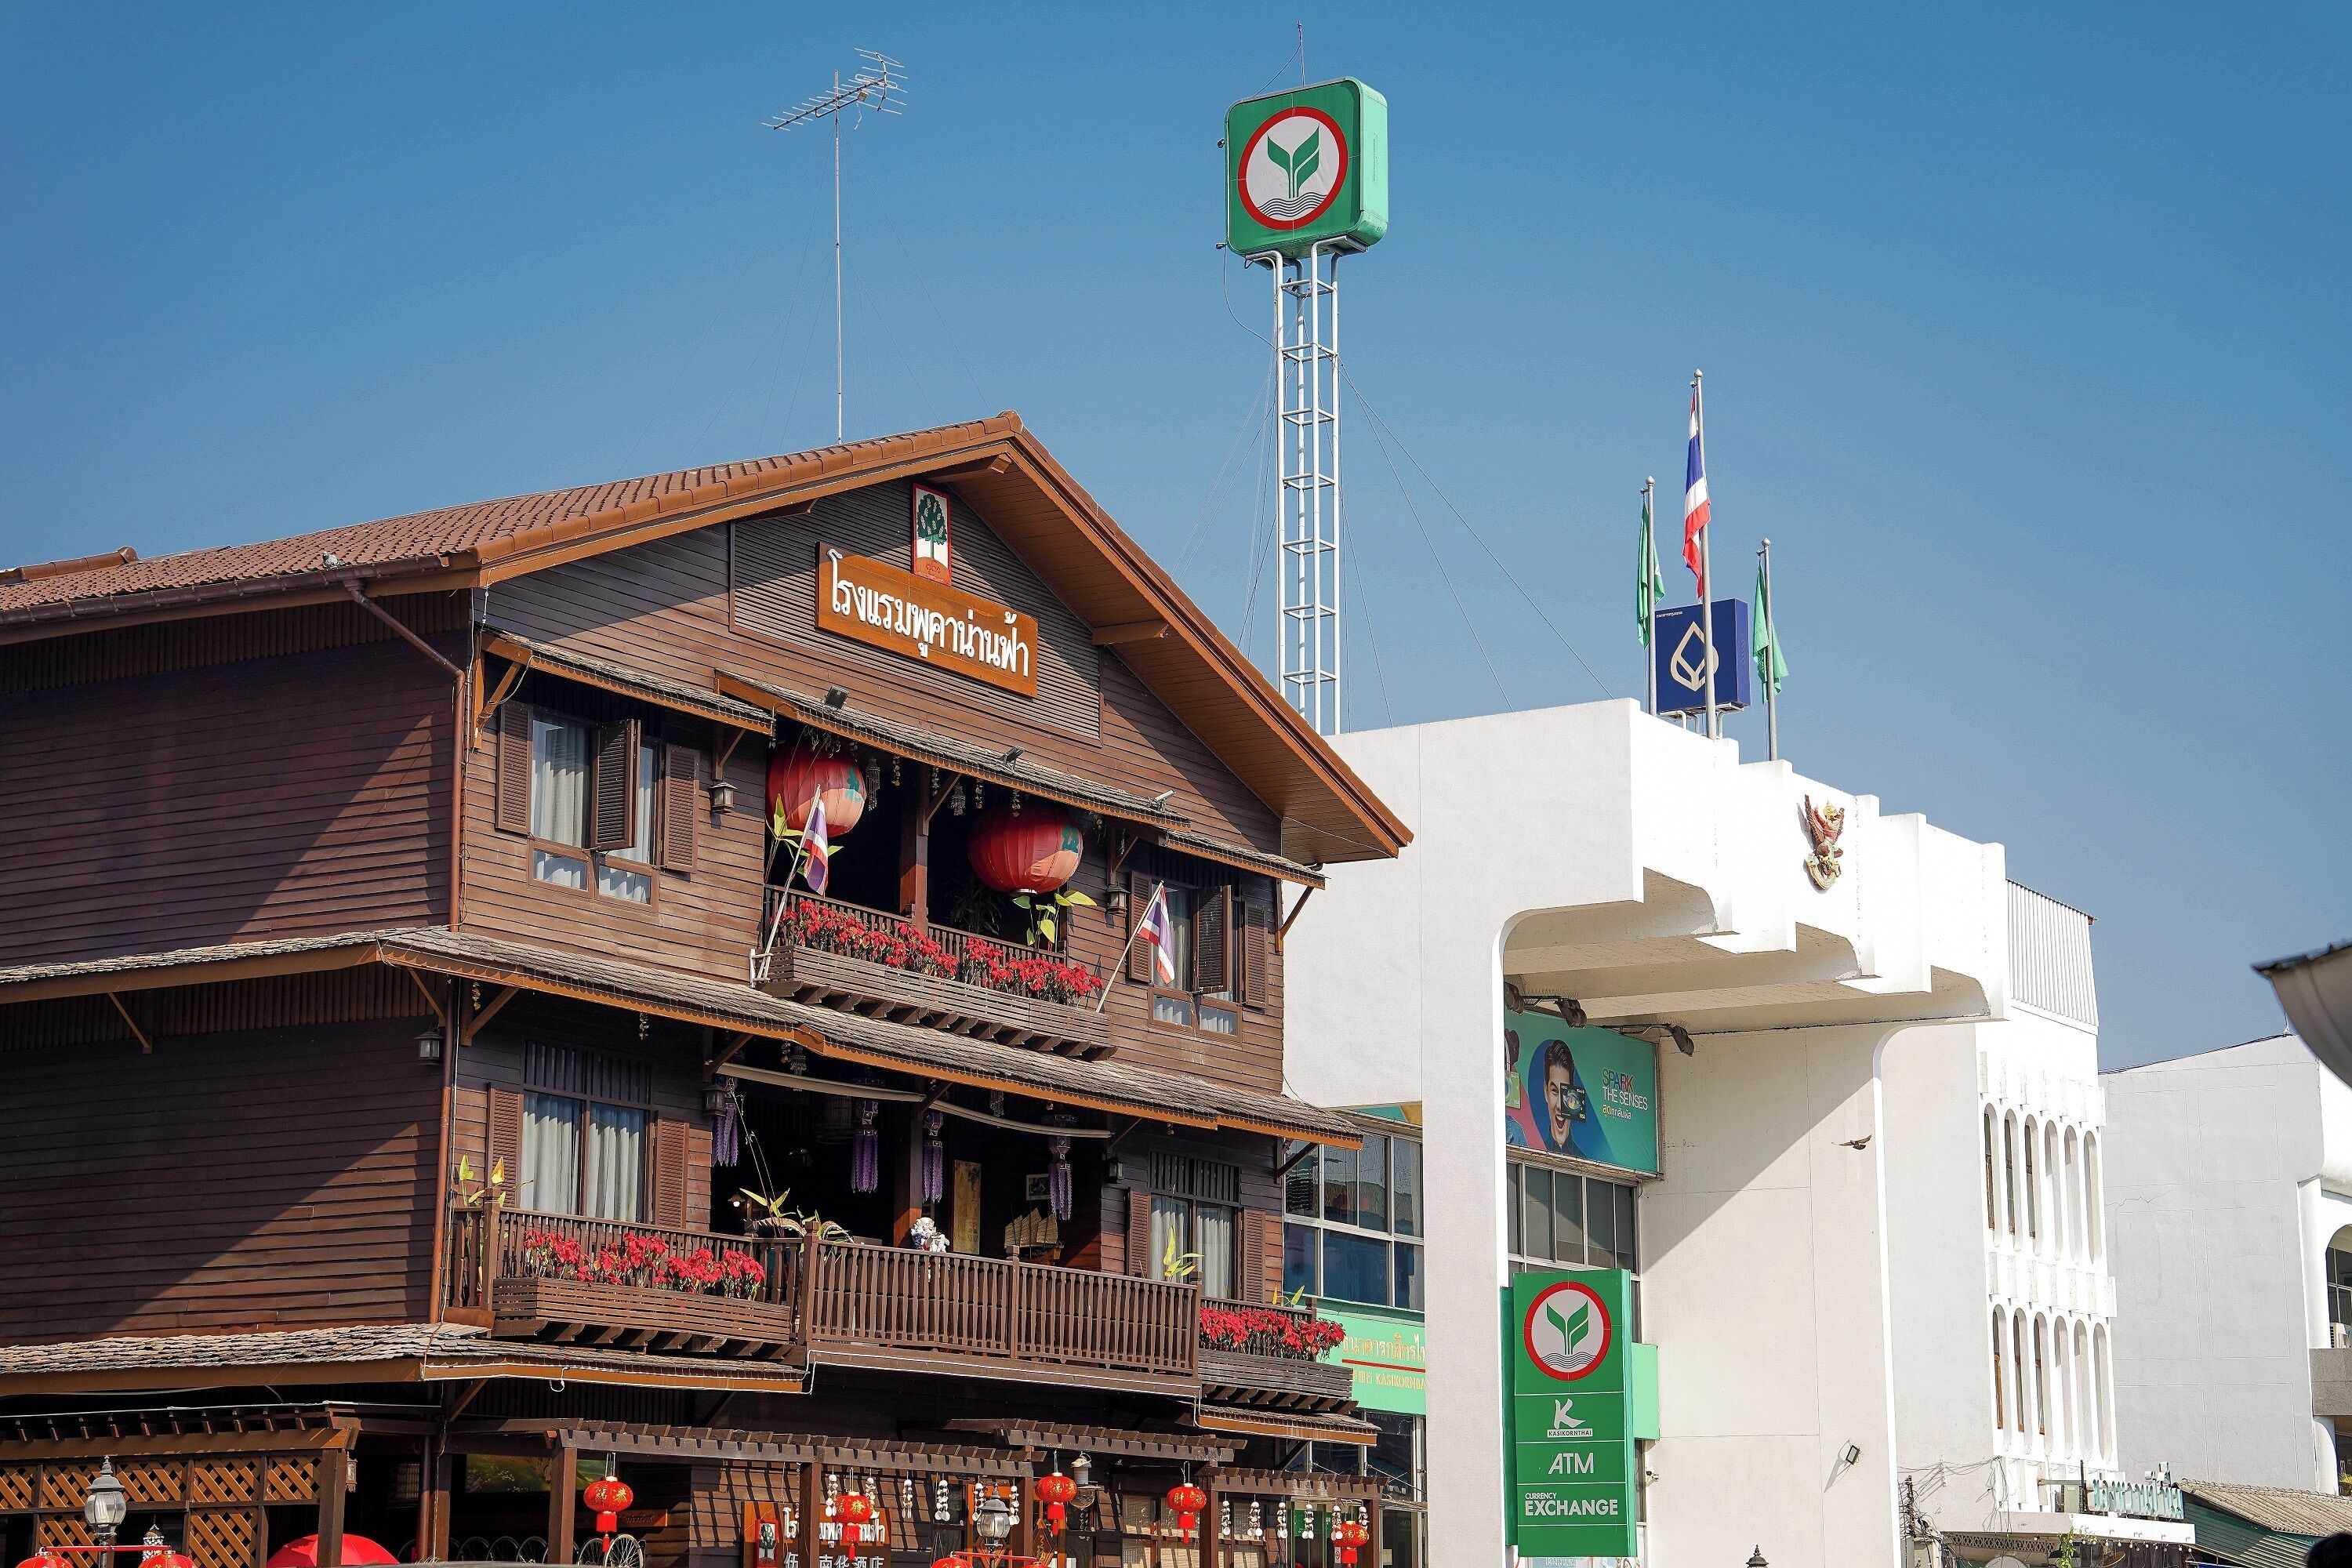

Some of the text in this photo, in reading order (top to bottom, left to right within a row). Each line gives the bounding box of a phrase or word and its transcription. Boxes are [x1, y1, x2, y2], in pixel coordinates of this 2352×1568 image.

[827, 549, 1029, 677] โรงแรมพูคาน่านฟ้า
[1602, 1068, 1635, 1094] SPARK
[1602, 1086, 1648, 1111] THE SENSES
[1553, 1399, 1587, 1429] K
[1548, 1453, 1594, 1475] ATM
[1525, 1499, 1618, 1516] EXCHANGE
